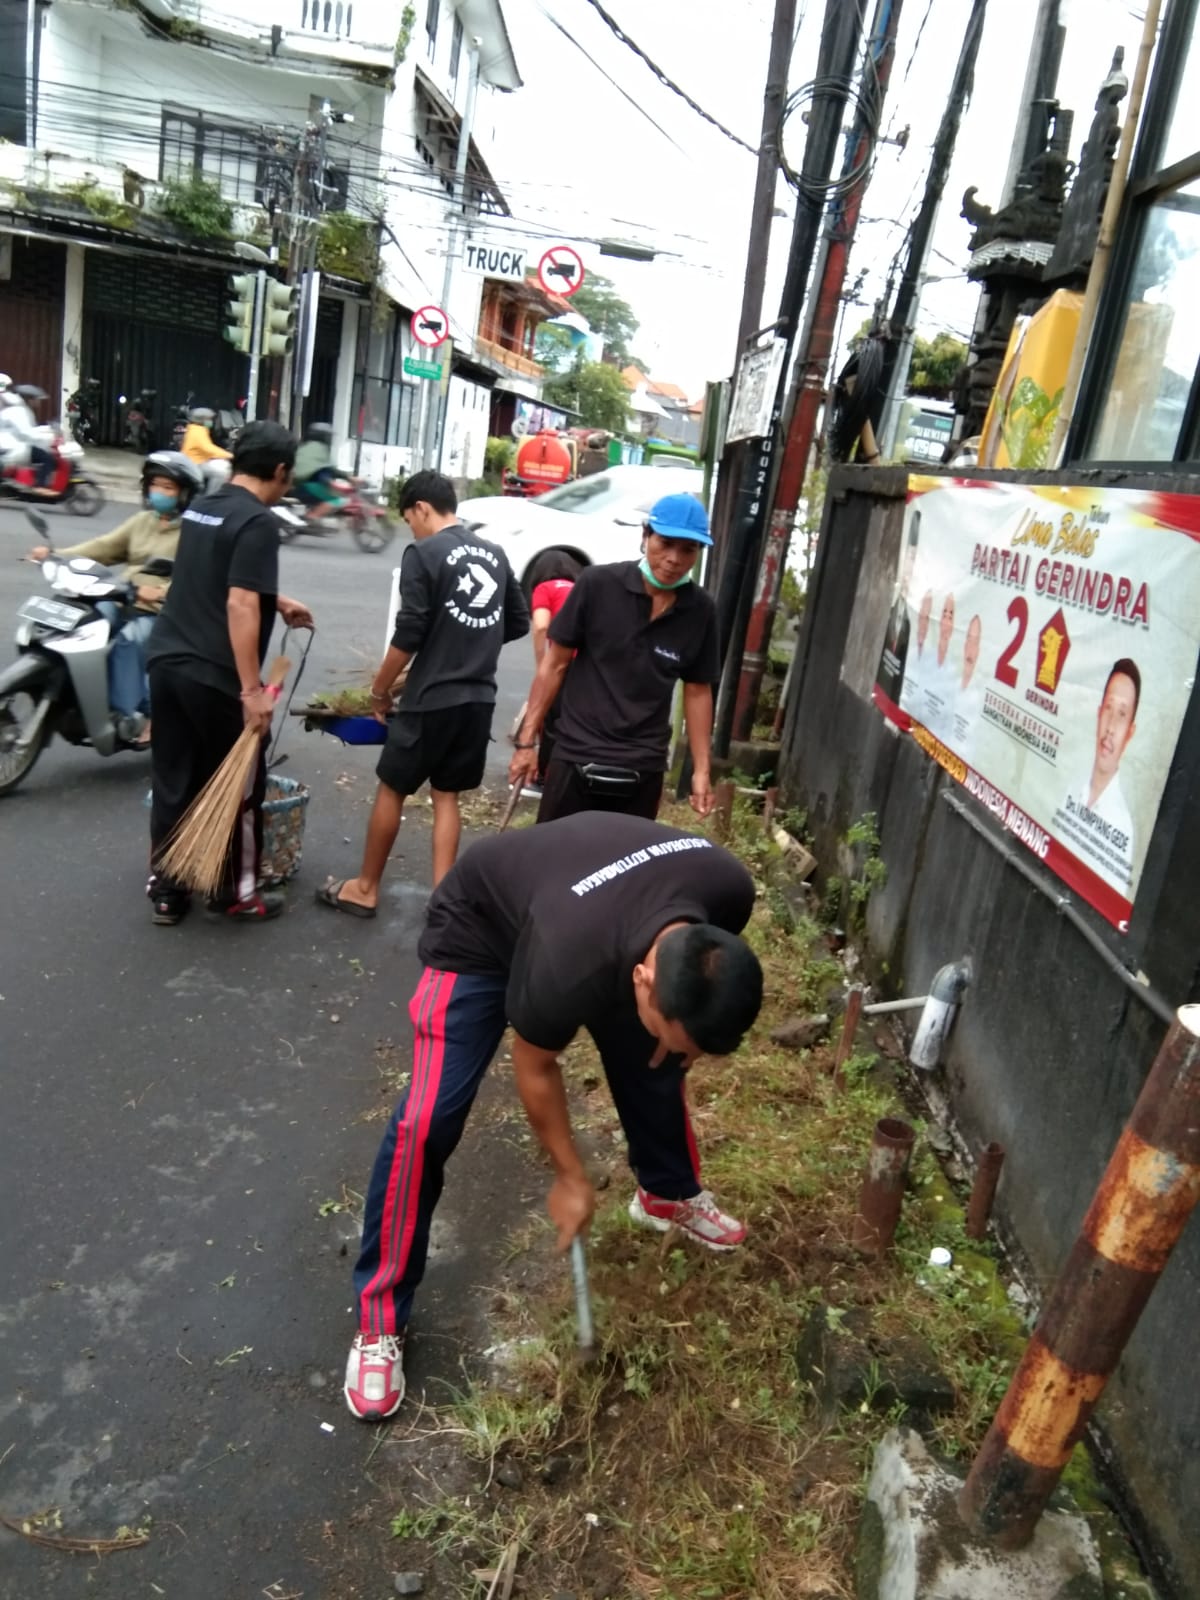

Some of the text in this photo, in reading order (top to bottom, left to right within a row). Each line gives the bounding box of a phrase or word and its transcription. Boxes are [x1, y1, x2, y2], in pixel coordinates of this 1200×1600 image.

[466, 245, 523, 277] TRUCK
[1010, 507, 1100, 559] Lima Belas
[971, 542, 1149, 627] PARTAI GERINDRA
[994, 595, 1030, 689] 2
[964, 768, 1008, 821] INDONESIA
[1005, 803, 1050, 859] MENANG
